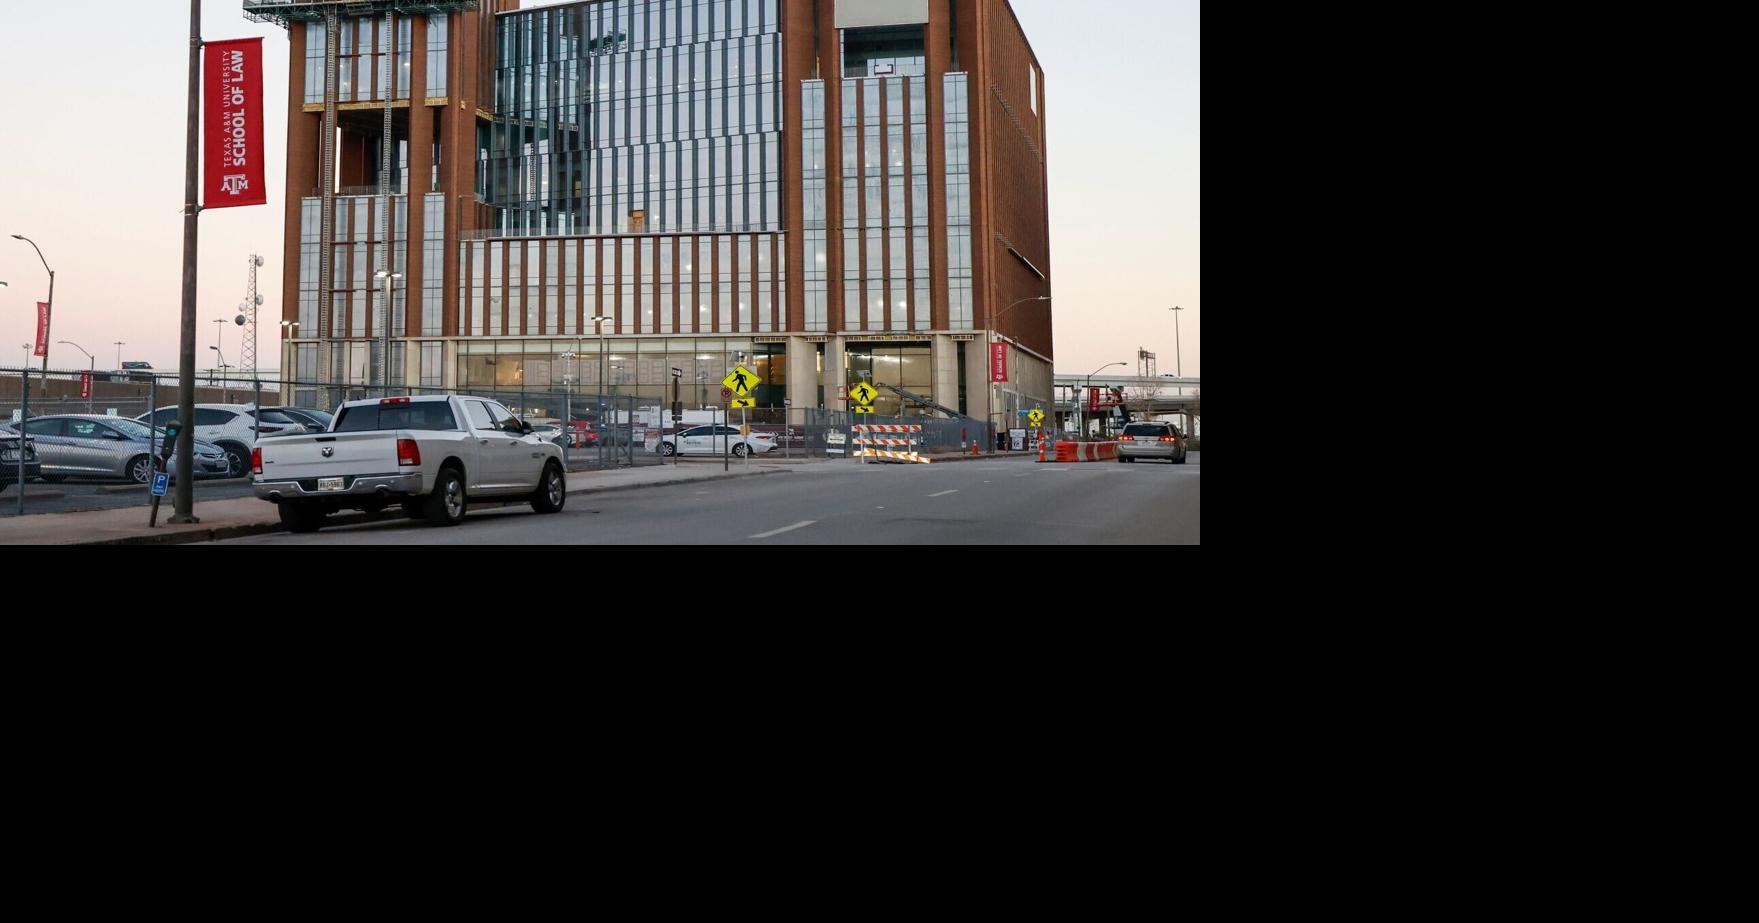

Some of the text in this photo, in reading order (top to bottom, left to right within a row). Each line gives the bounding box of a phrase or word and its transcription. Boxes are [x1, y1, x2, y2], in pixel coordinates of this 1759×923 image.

[222, 50, 232, 168] TEXAS A&M UNIVERSITY
[231, 50, 245, 166] SCHOOL OF LAW
[158, 475, 166, 483] P
